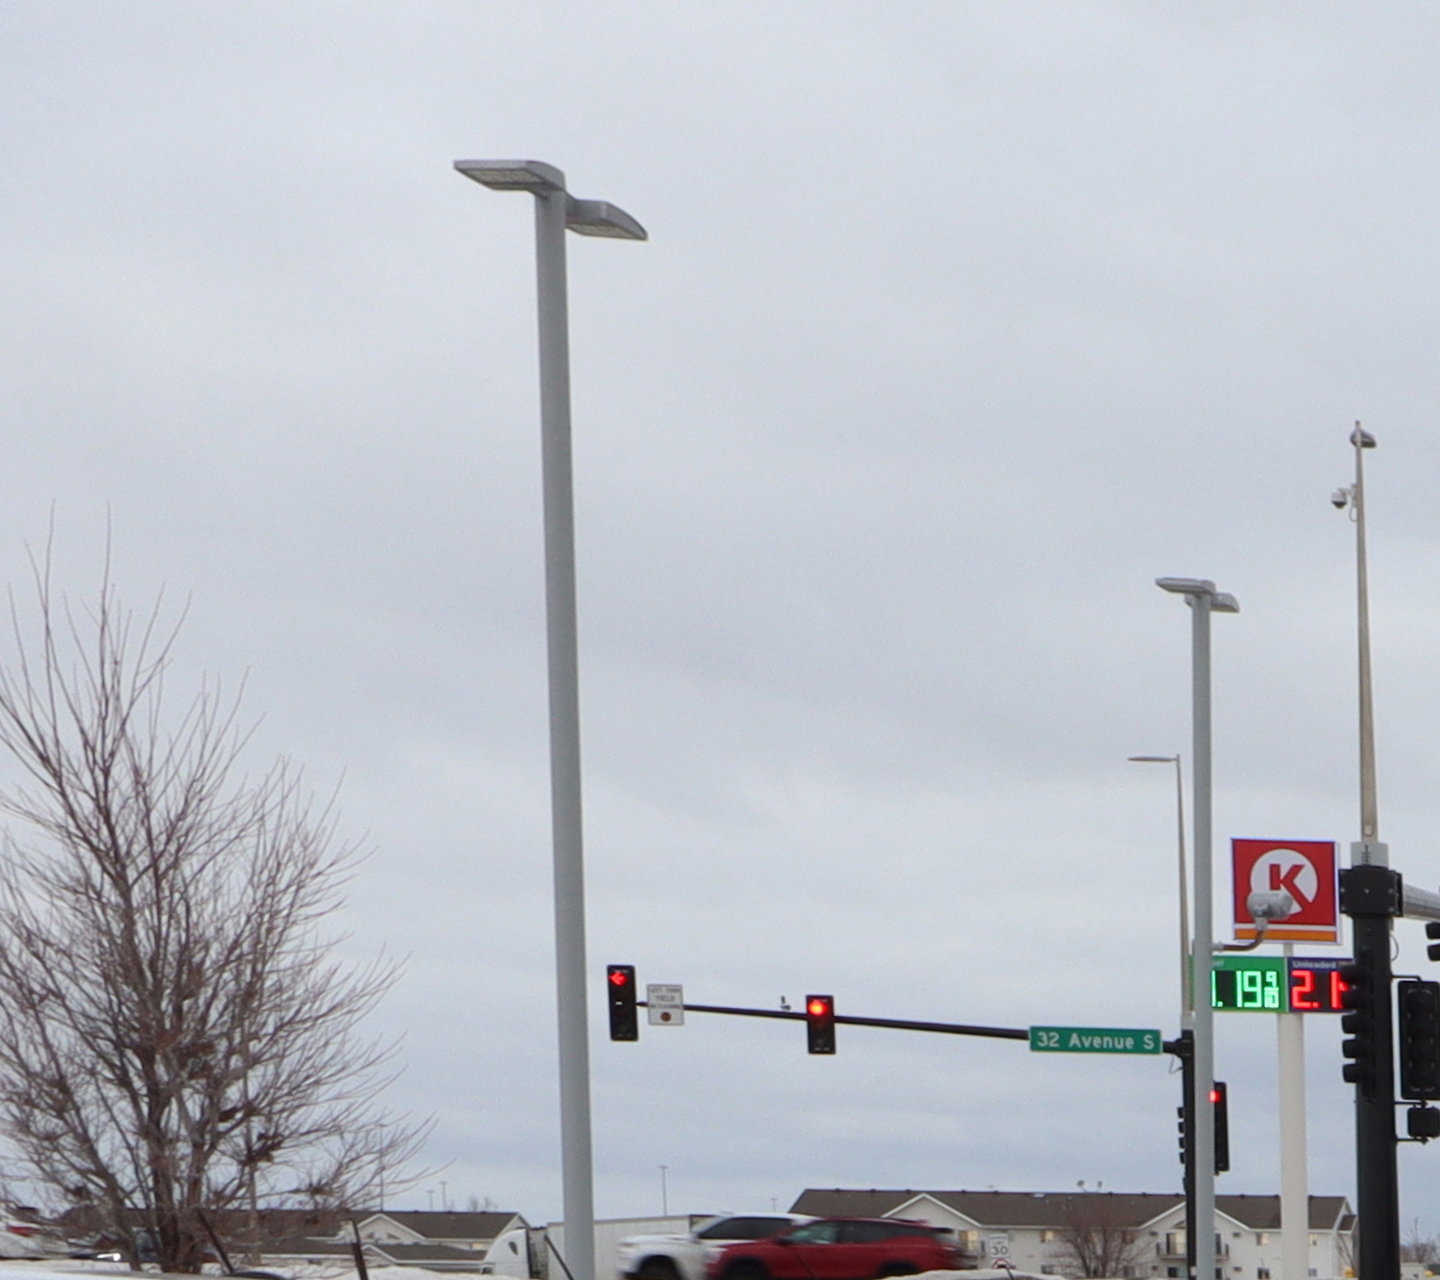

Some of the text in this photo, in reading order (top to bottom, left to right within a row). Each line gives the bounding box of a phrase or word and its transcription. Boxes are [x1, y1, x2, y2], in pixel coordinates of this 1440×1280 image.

[1037, 1031, 1155, 1050] 32 Avenue S
